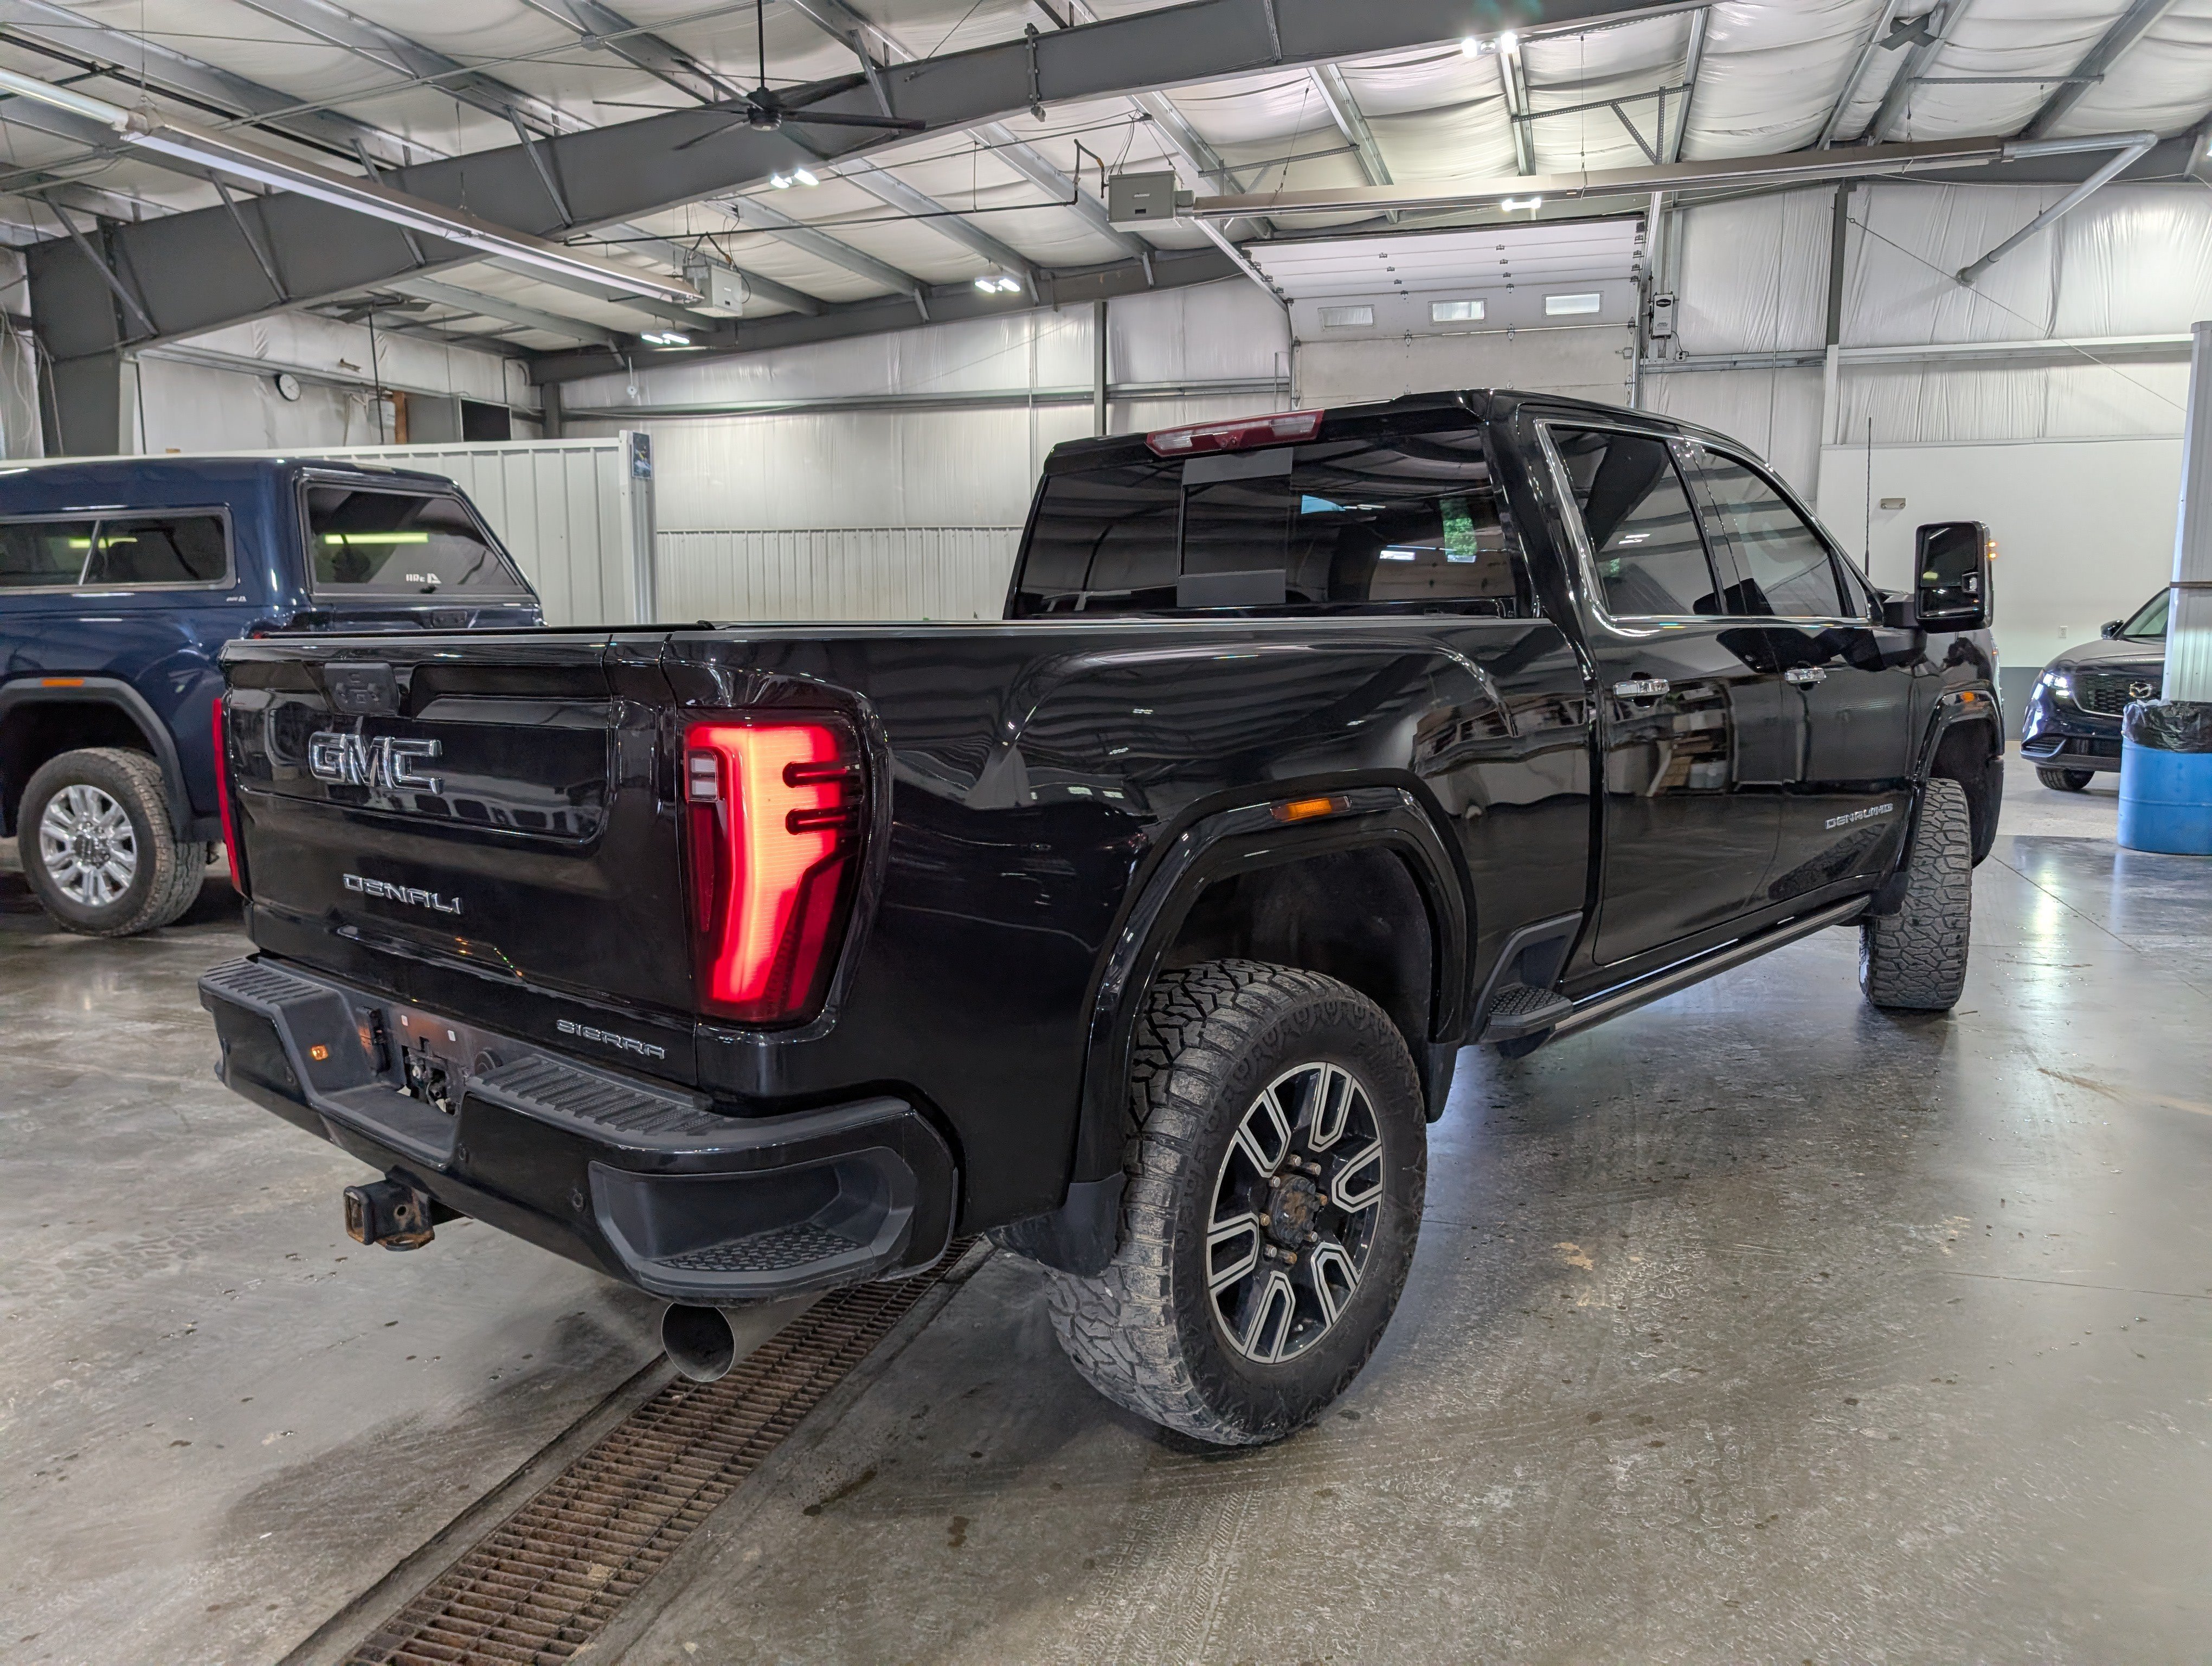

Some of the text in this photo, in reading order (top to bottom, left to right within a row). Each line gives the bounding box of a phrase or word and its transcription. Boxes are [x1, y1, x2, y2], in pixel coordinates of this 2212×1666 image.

[308, 732, 443, 794] GMC
[343, 873, 462, 915] DENALI
[556, 1019, 665, 1059] SIERRA
